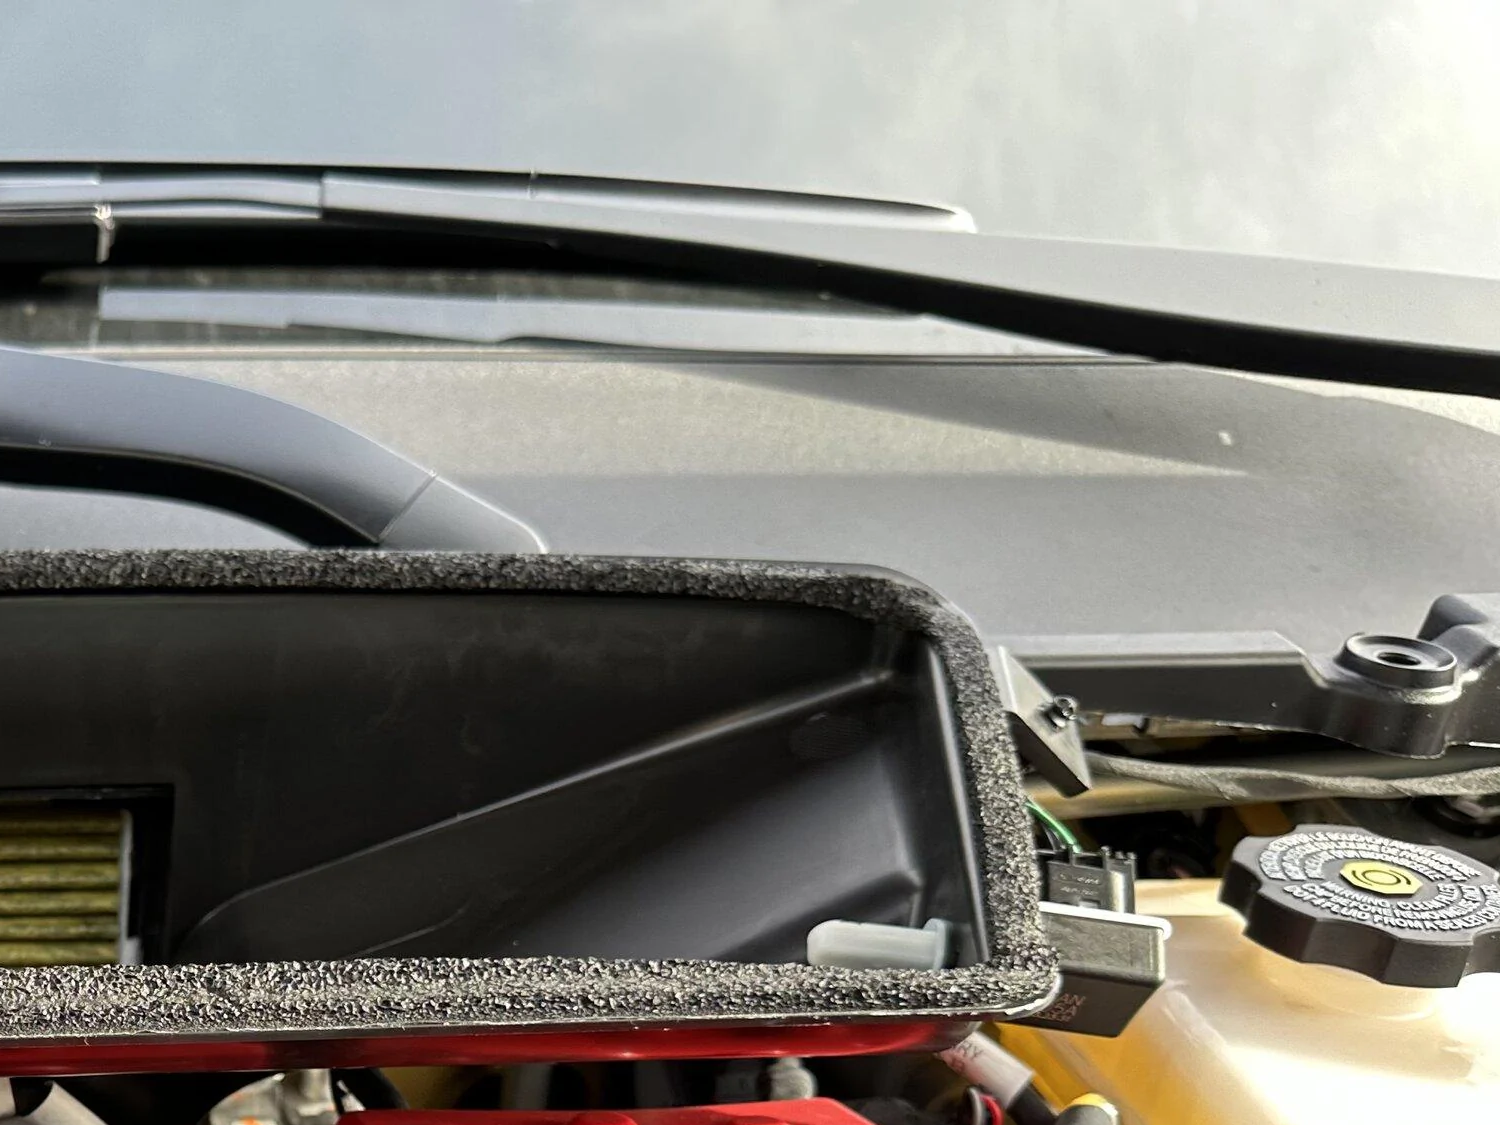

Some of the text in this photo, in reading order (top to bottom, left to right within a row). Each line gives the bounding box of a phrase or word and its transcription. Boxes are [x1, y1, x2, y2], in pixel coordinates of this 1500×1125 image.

[1321, 901, 1370, 921] FLUID
[1373, 914, 1422, 929] FROM
[1331, 896, 1392, 917] BEFORE
